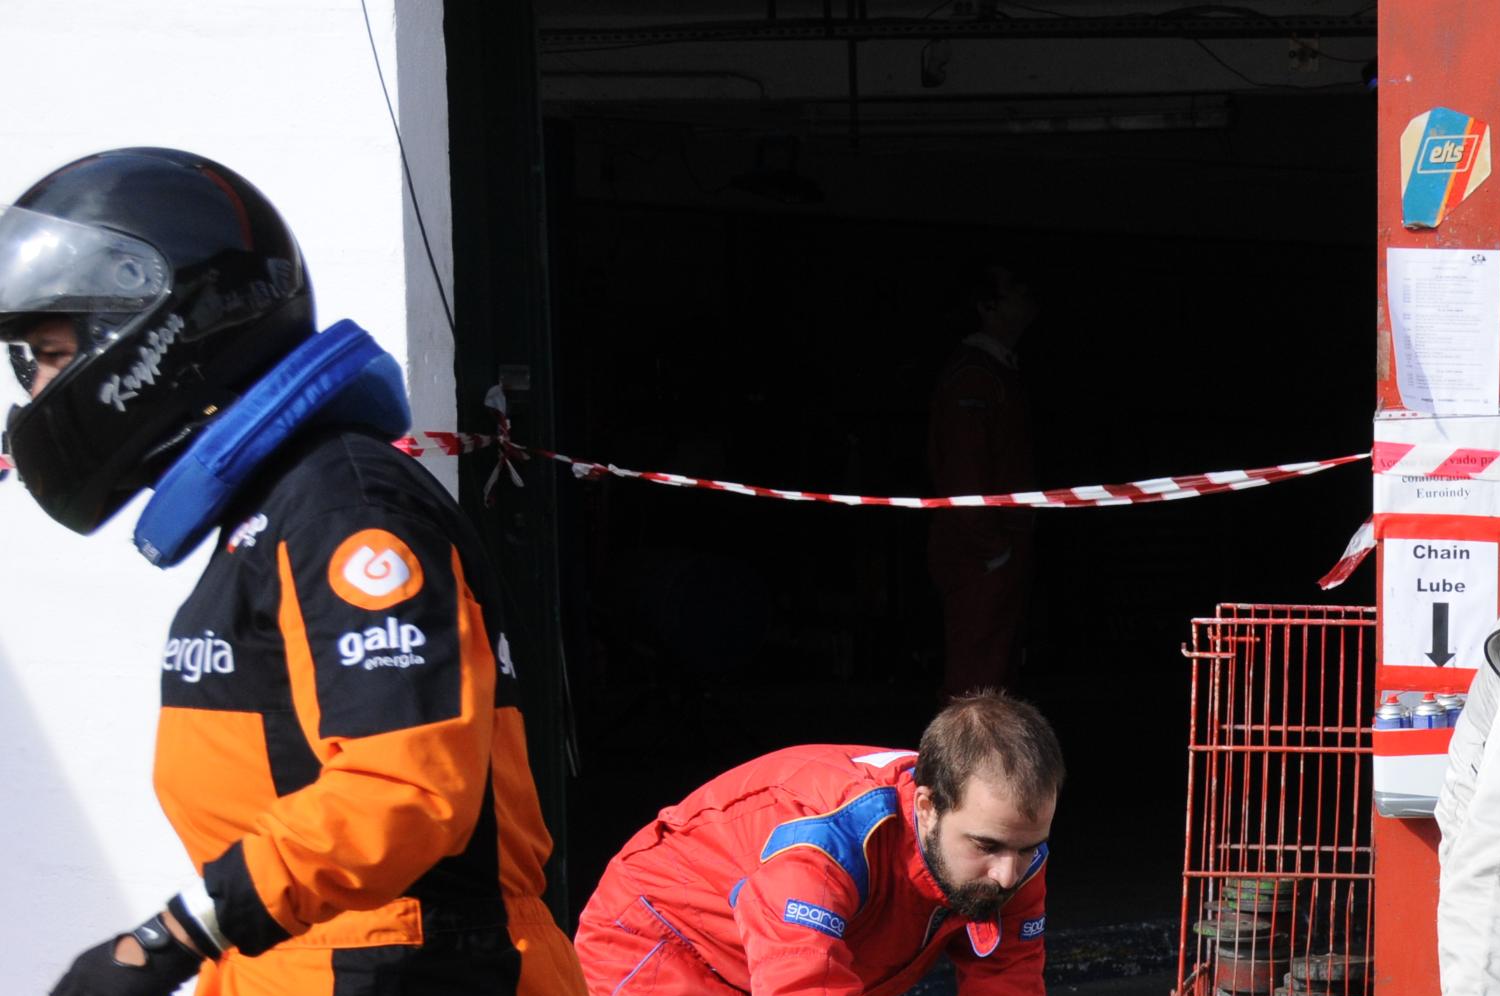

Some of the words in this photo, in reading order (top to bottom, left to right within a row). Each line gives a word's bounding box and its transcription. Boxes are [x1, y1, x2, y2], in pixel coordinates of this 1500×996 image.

[100, 313, 185, 412] Krypton
[1416, 487, 1471, 500] Euroindy
[1413, 545, 1470, 560] Chain
[1417, 578, 1466, 593] Lube
[338, 616, 426, 666] galp
[364, 652, 426, 671] energia
[787, 902, 845, 933] sparco
